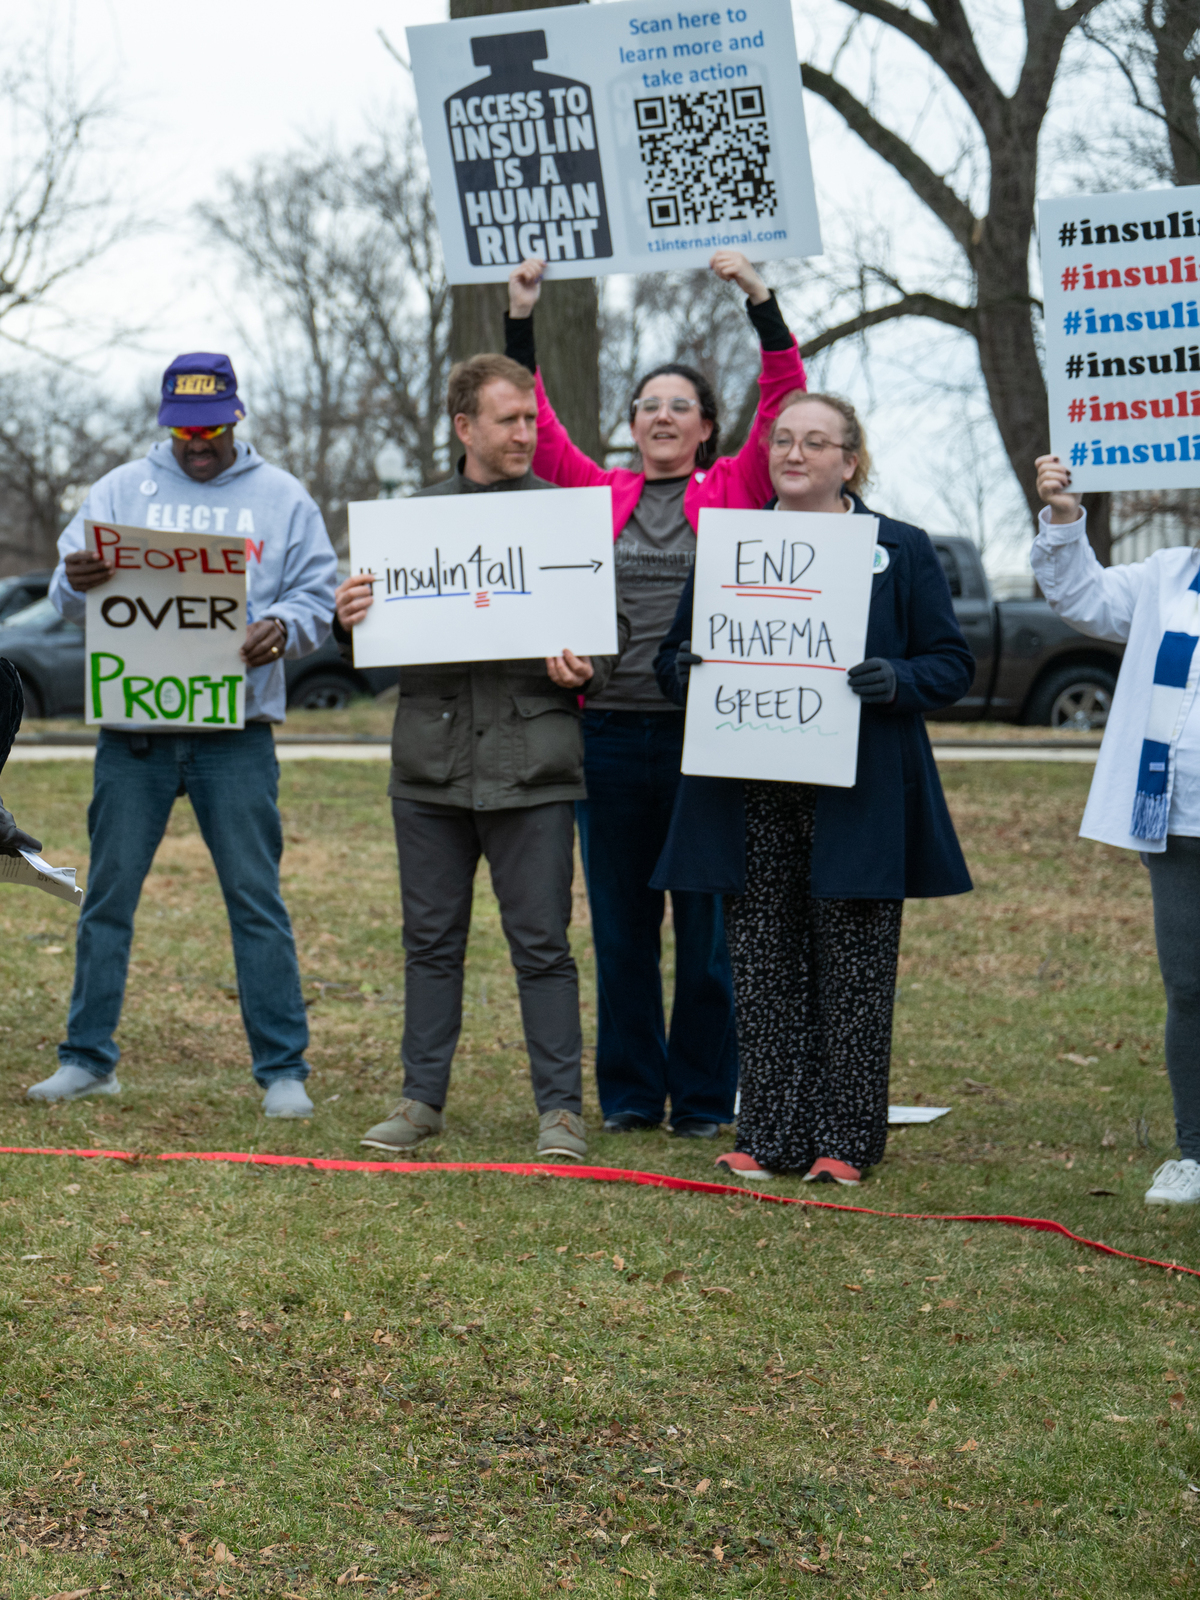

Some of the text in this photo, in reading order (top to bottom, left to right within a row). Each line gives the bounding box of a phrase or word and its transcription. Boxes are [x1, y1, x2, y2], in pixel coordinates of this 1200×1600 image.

[629, 8, 748, 36] Scan here to
[618, 30, 765, 64] learn more and
[641, 62, 748, 88] take action
[450, 85, 589, 127] ACCESS TO
[450, 114, 596, 163] INSULIN
[493, 154, 561, 189] IS A
[464, 182, 601, 227] HUMAN
[476, 218, 599, 266] RIGHT
[1058, 209, 1200, 248] #insuli
[1060, 255, 1200, 292] #insuli
[146, 503, 255, 534] ELECT A
[93, 525, 246, 574] PEOPLE
[736, 540, 816, 585] END
[101, 595, 240, 631] OVER
[709, 612, 836, 664] PHARMA
[90, 651, 244, 724] PROFIT
[715, 684, 823, 725] GREED
